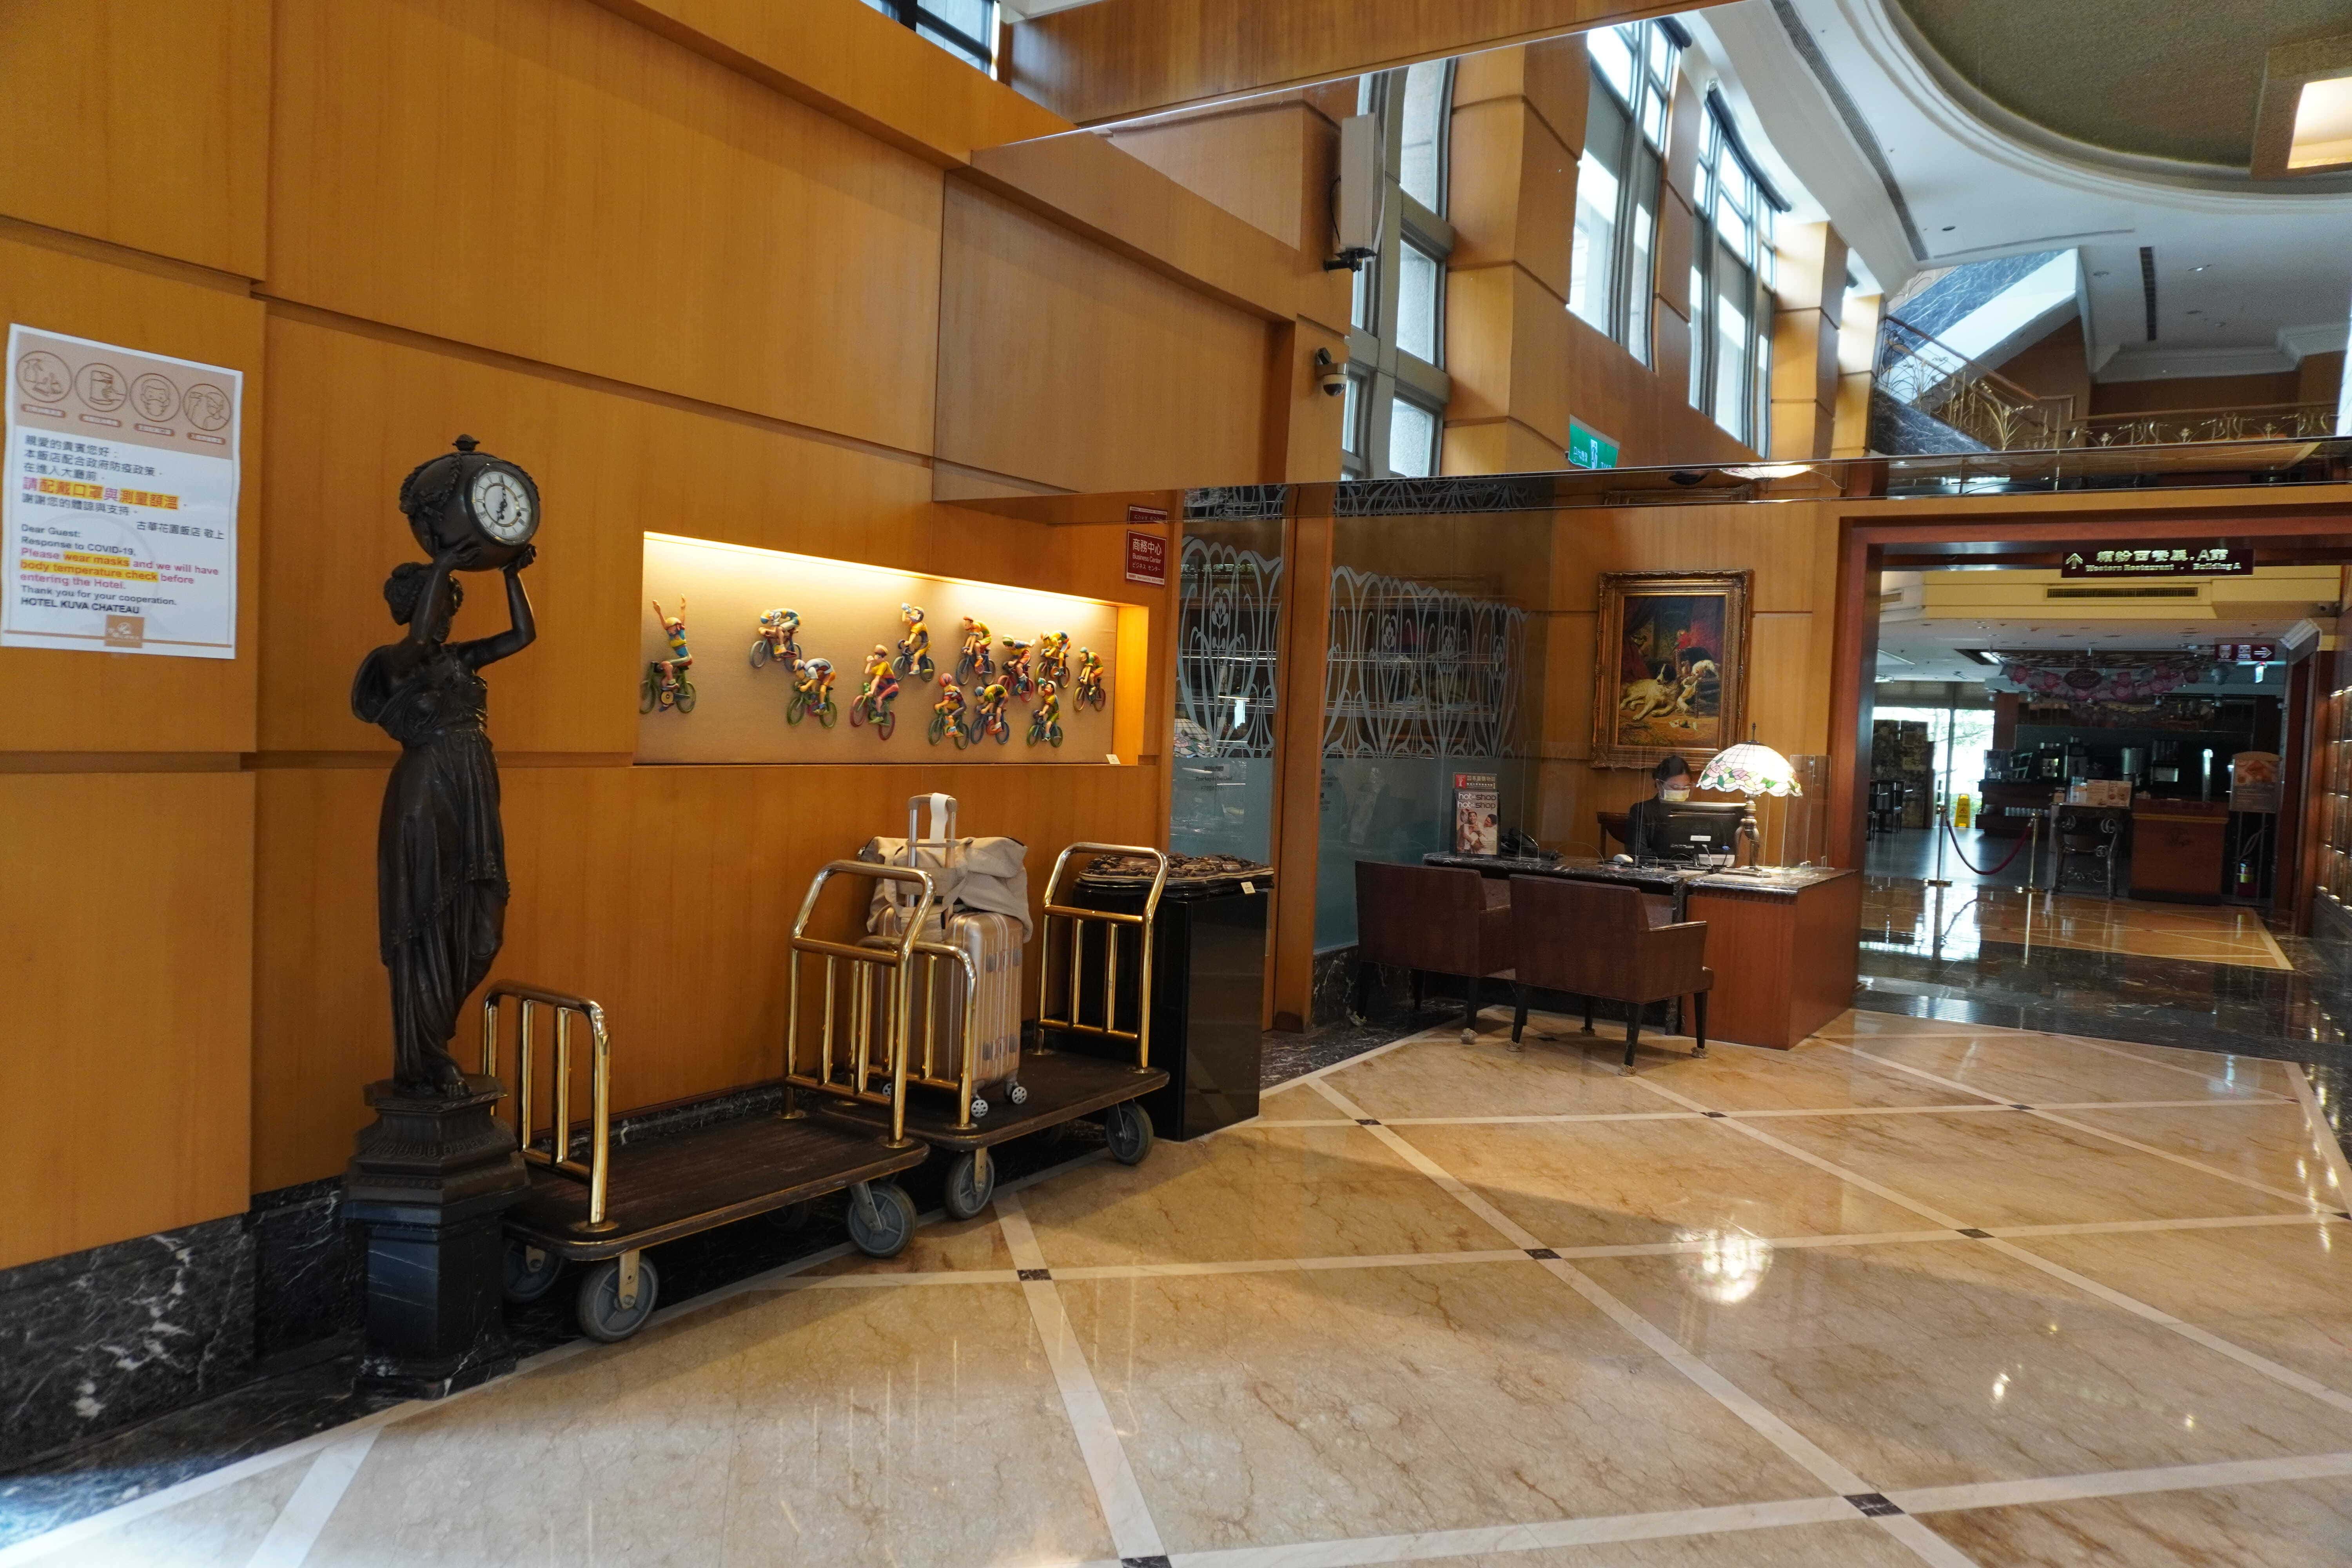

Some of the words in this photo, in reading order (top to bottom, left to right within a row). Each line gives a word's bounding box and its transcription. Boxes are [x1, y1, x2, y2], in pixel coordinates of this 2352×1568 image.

[21, 524, 45, 534] Dear
[48, 527, 81, 537] Guest:
[136, 521, 201, 537] 古華花園飯店
[204, 528, 225, 540] 敬上
[21, 536, 72, 549] Response
[1132, 538, 1162, 555] 商務中心
[21, 547, 60, 559] Please
[64, 553, 91, 563] wear
[94, 556, 129, 567] masks
[133, 561, 153, 569] and
[174, 564, 191, 572] will
[195, 565, 219, 575] have
[1132, 553, 1149, 562] Business
[1132, 561, 1146, 570] ビジネス
[20, 560, 49, 572] body
[53, 564, 122, 577] temperature
[125, 570, 157, 581] check
[161, 574, 194, 584] before
[20, 573, 69, 586] entering
[73, 577, 90, 586] the
[94, 579, 126, 589] Hotel.
[21, 585, 52, 595] Thank
[119, 595, 177, 605] cooperation.
[21, 597, 58, 607] HOTEL
[60, 600, 89, 610] KUVA
[91, 603, 140, 614] CHATEAU
